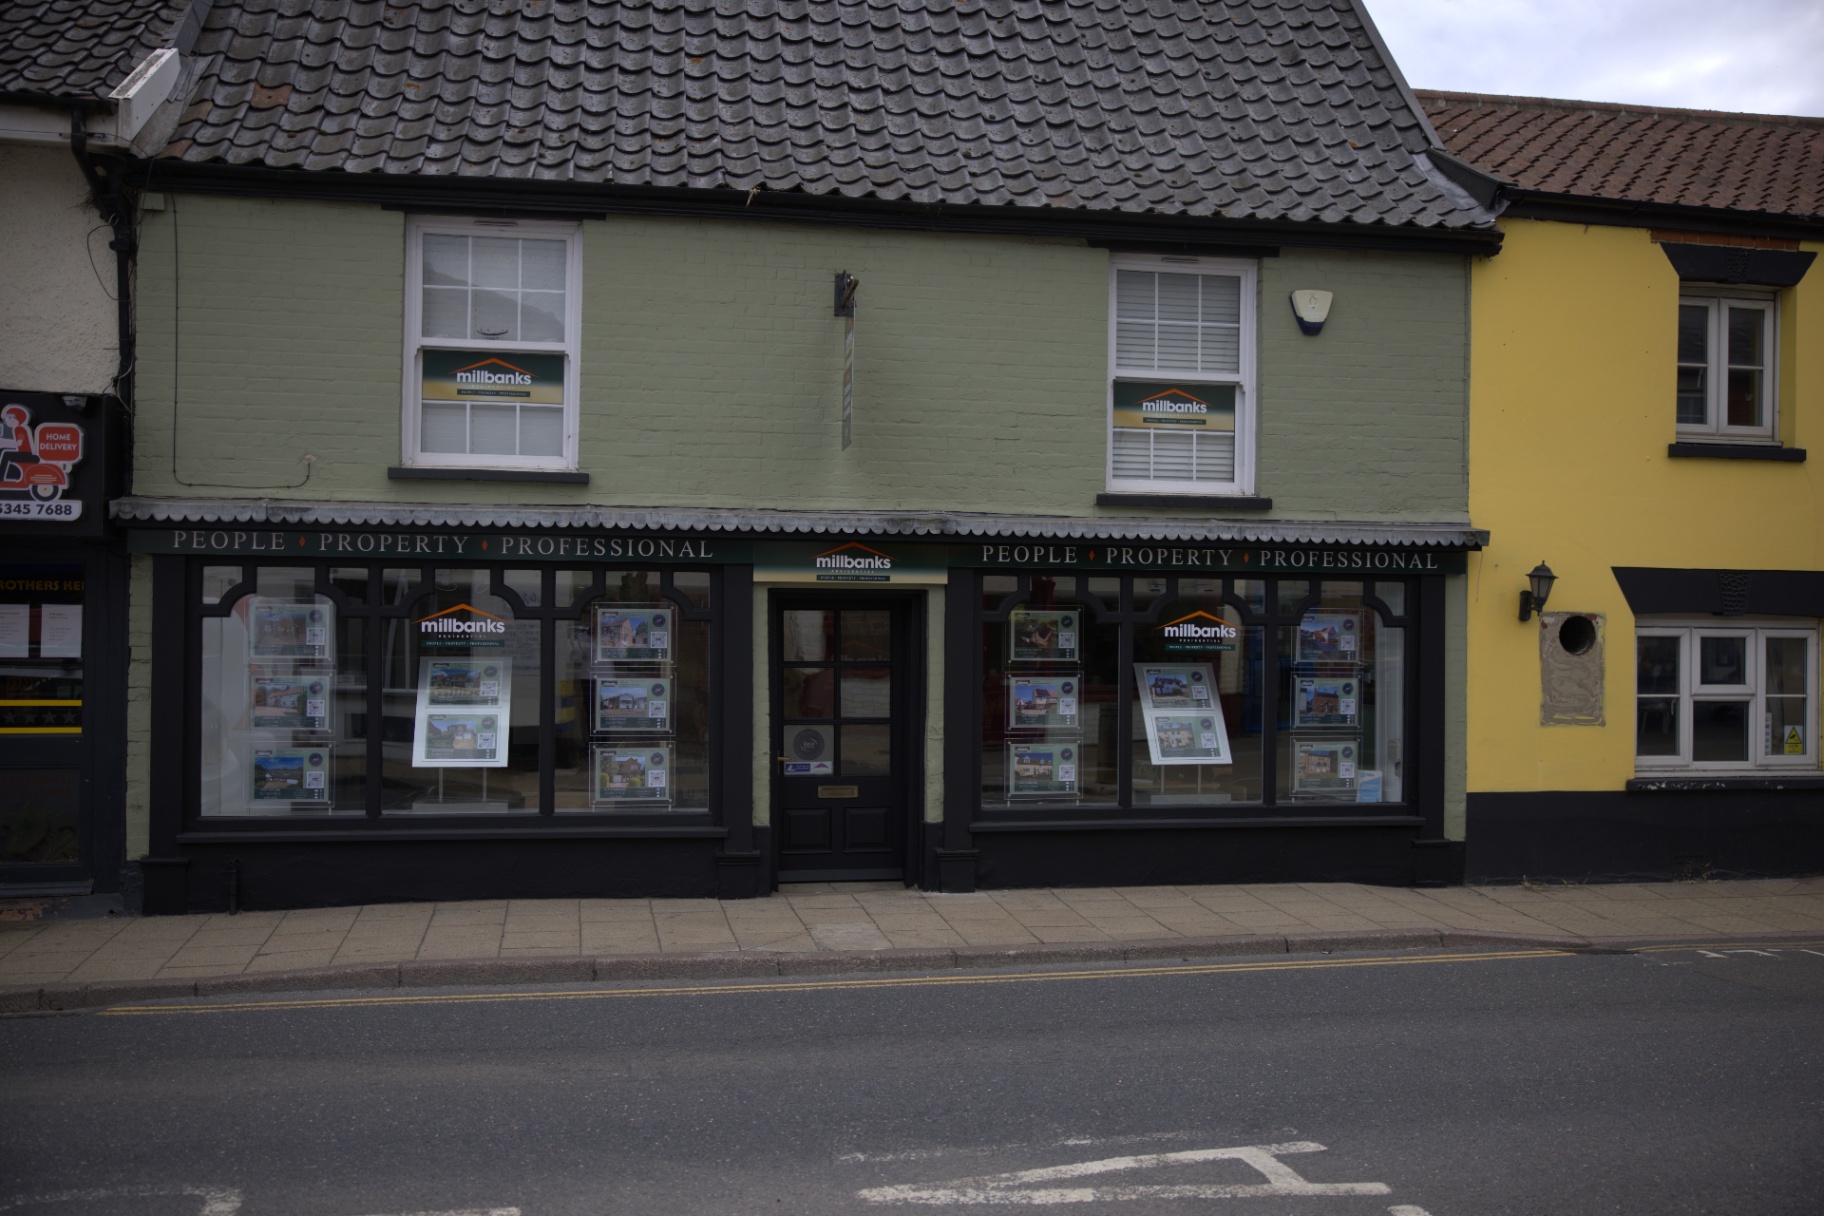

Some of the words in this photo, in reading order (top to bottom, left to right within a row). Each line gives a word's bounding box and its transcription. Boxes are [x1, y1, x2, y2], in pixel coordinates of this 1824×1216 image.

[456, 370, 532, 385] millbanks
[1142, 400, 1207, 414] millbanks
[46, 433, 71, 441] HOME
[40, 442, 77, 451] DELIVERY
[36, 504, 72, 516] 7688
[172, 530, 285, 550] PEOPLE
[319, 533, 470, 553] PROPERTY
[501, 537, 714, 558] PROFESSIONAL
[816, 555, 892, 569] millbanks
[982, 545, 1078, 564] PEOPLE
[1106, 547, 1234, 566] PROPERTY
[1259, 550, 1439, 569] PROFESSIONAL
[421, 618, 505, 633] millbanks
[1164, 624, 1237, 638] millbanks
